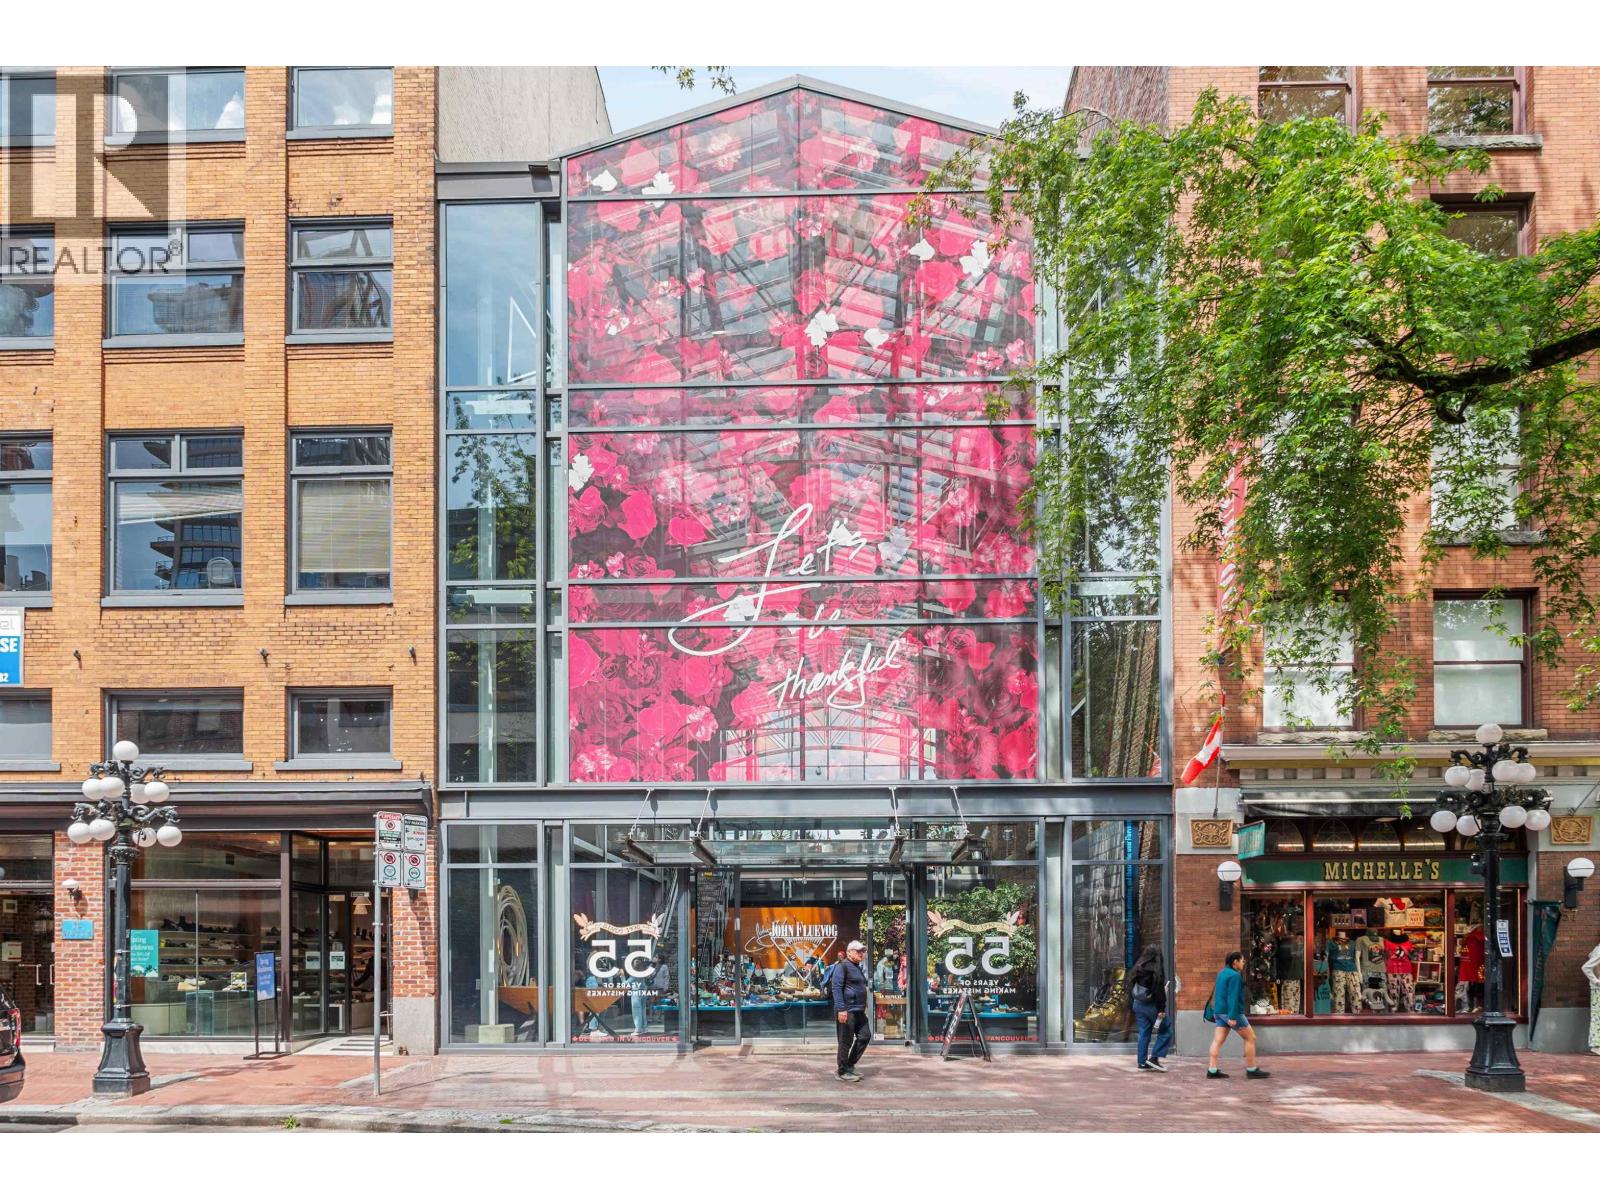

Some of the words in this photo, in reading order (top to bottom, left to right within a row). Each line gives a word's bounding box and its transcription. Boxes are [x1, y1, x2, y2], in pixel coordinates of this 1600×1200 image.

[767, 639, 902, 709] thankful
[1325, 859, 1440, 881] MICHELLE'S
[771, 921, 794, 937] JOHN
